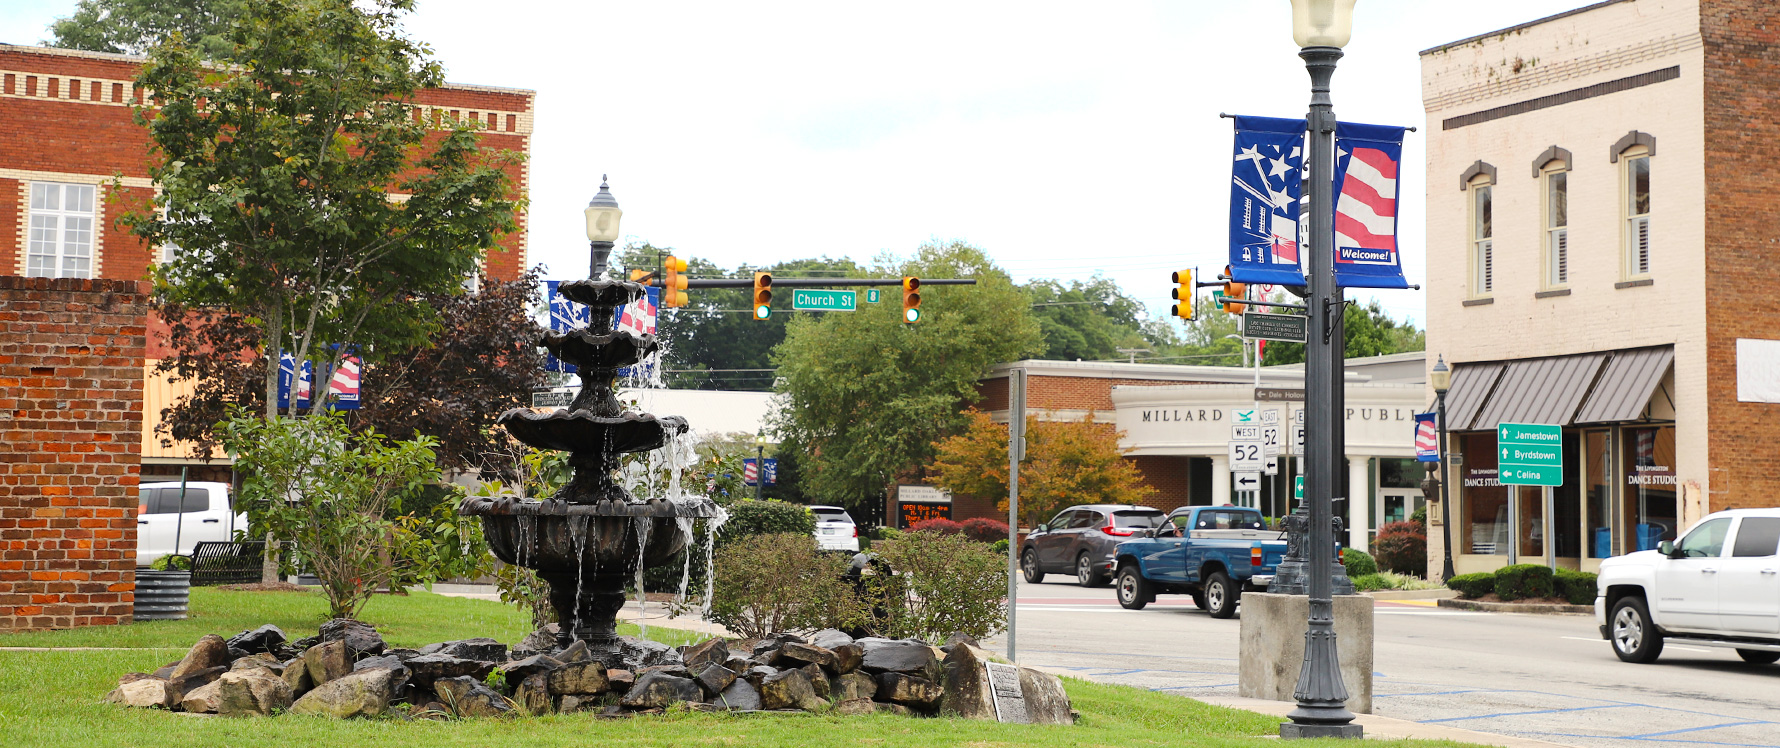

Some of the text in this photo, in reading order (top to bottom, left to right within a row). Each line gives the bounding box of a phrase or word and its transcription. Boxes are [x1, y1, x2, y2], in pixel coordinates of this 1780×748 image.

[1342, 248, 1389, 260] Welcome!
[798, 293, 852, 306] Church St
[870, 291, 877, 301] 8
[1285, 391, 1305, 399] Hollow
[1142, 408, 1426, 422] MILLARD PUBLI
[1265, 412, 1276, 422] EAST
[1235, 427, 1257, 437] WEST
[1514, 430, 1559, 441] Jamestown
[1264, 429, 1277, 446] 52
[1235, 444, 1259, 461] 52
[1514, 449, 1556, 461] Byrdstown
[1516, 470, 1541, 480] Celina
[1628, 475, 1652, 485] DANCE
[1464, 478, 1484, 487] DANCE
